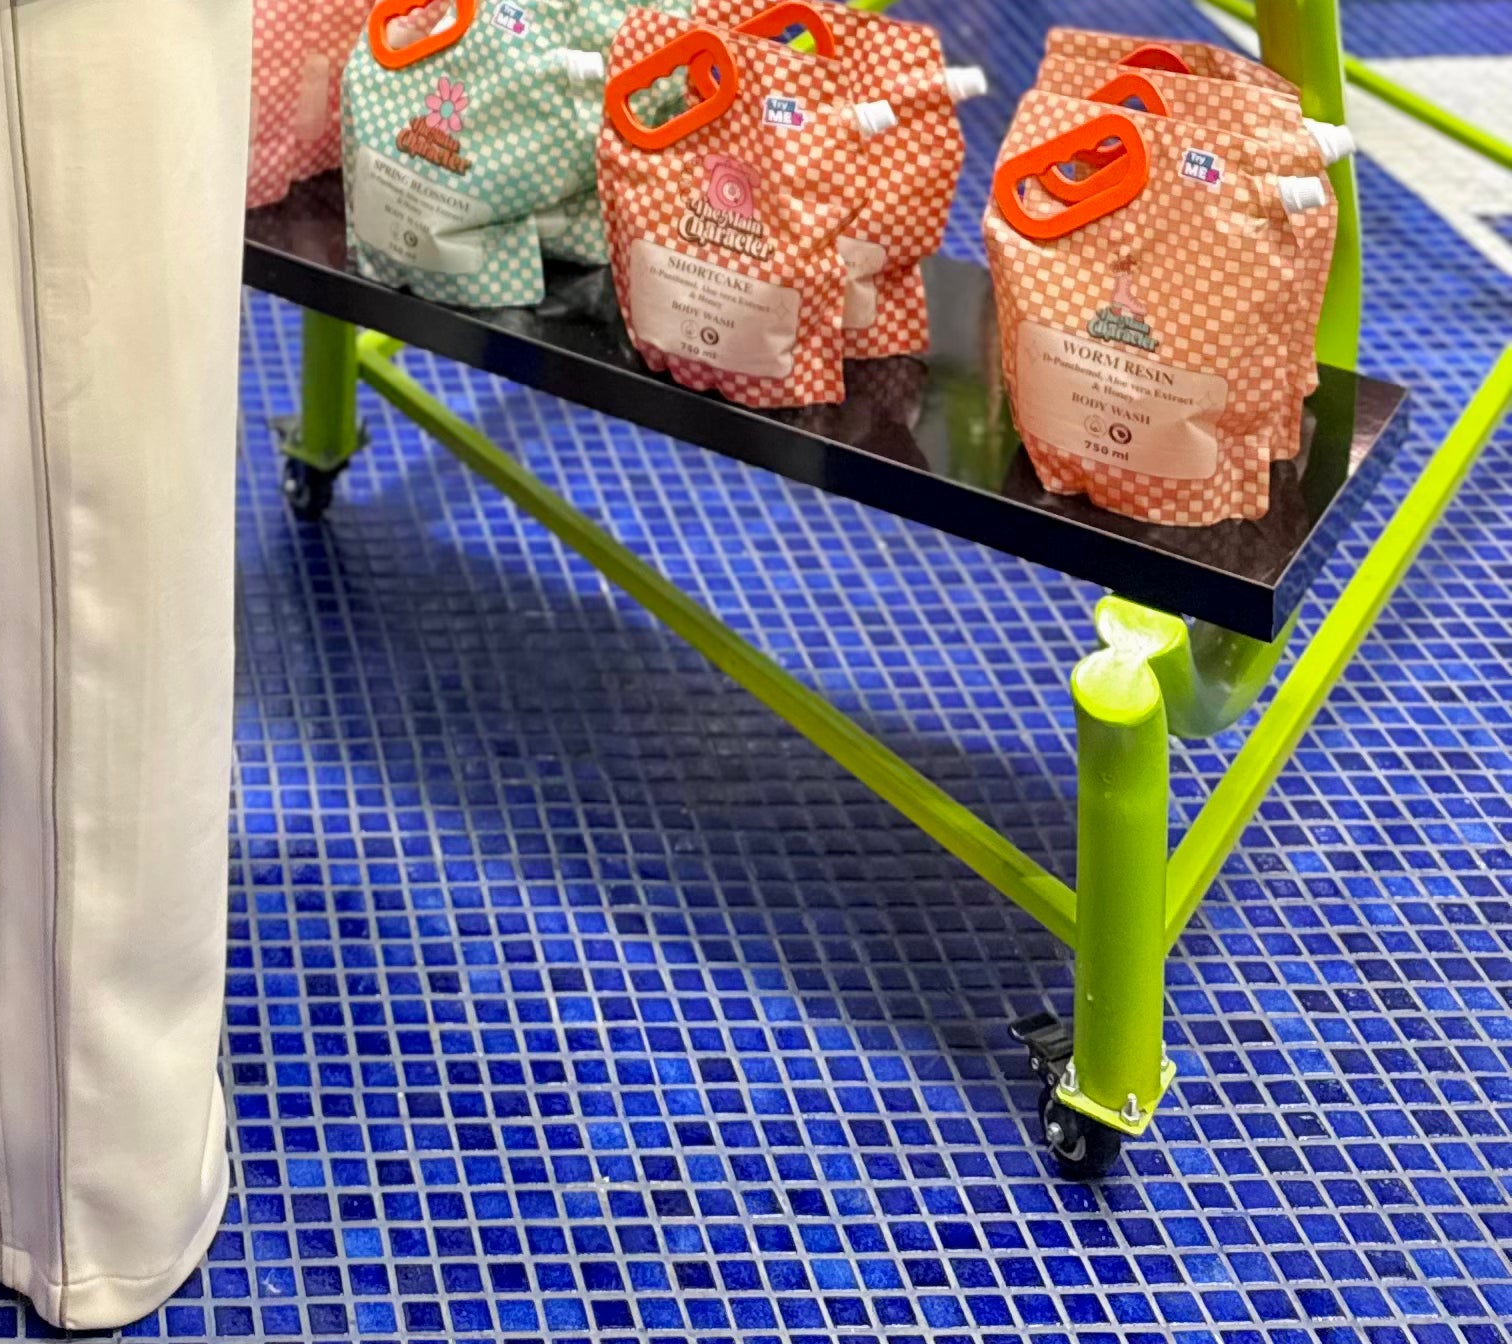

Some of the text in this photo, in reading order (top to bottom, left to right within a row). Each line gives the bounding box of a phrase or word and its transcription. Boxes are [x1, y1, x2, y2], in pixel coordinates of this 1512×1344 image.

[768, 109, 792, 124] ME
[1184, 161, 1207, 180] ME
[1191, 152, 1206, 165] Try
[373, 159, 409, 186] SPRING
[410, 178, 470, 213] BLOSSOM
[678, 211, 775, 262] Character
[668, 256, 754, 294] SHORTCAKE
[672, 299, 736, 329] BODY WASH
[1063, 339, 1176, 386] WORM RESIN
[1104, 385, 1135, 403] Honey
[1154, 389, 1194, 406] Extract
[1072, 391, 1151, 425] BODY WASH
[1084, 439, 1130, 461] 750 ml
